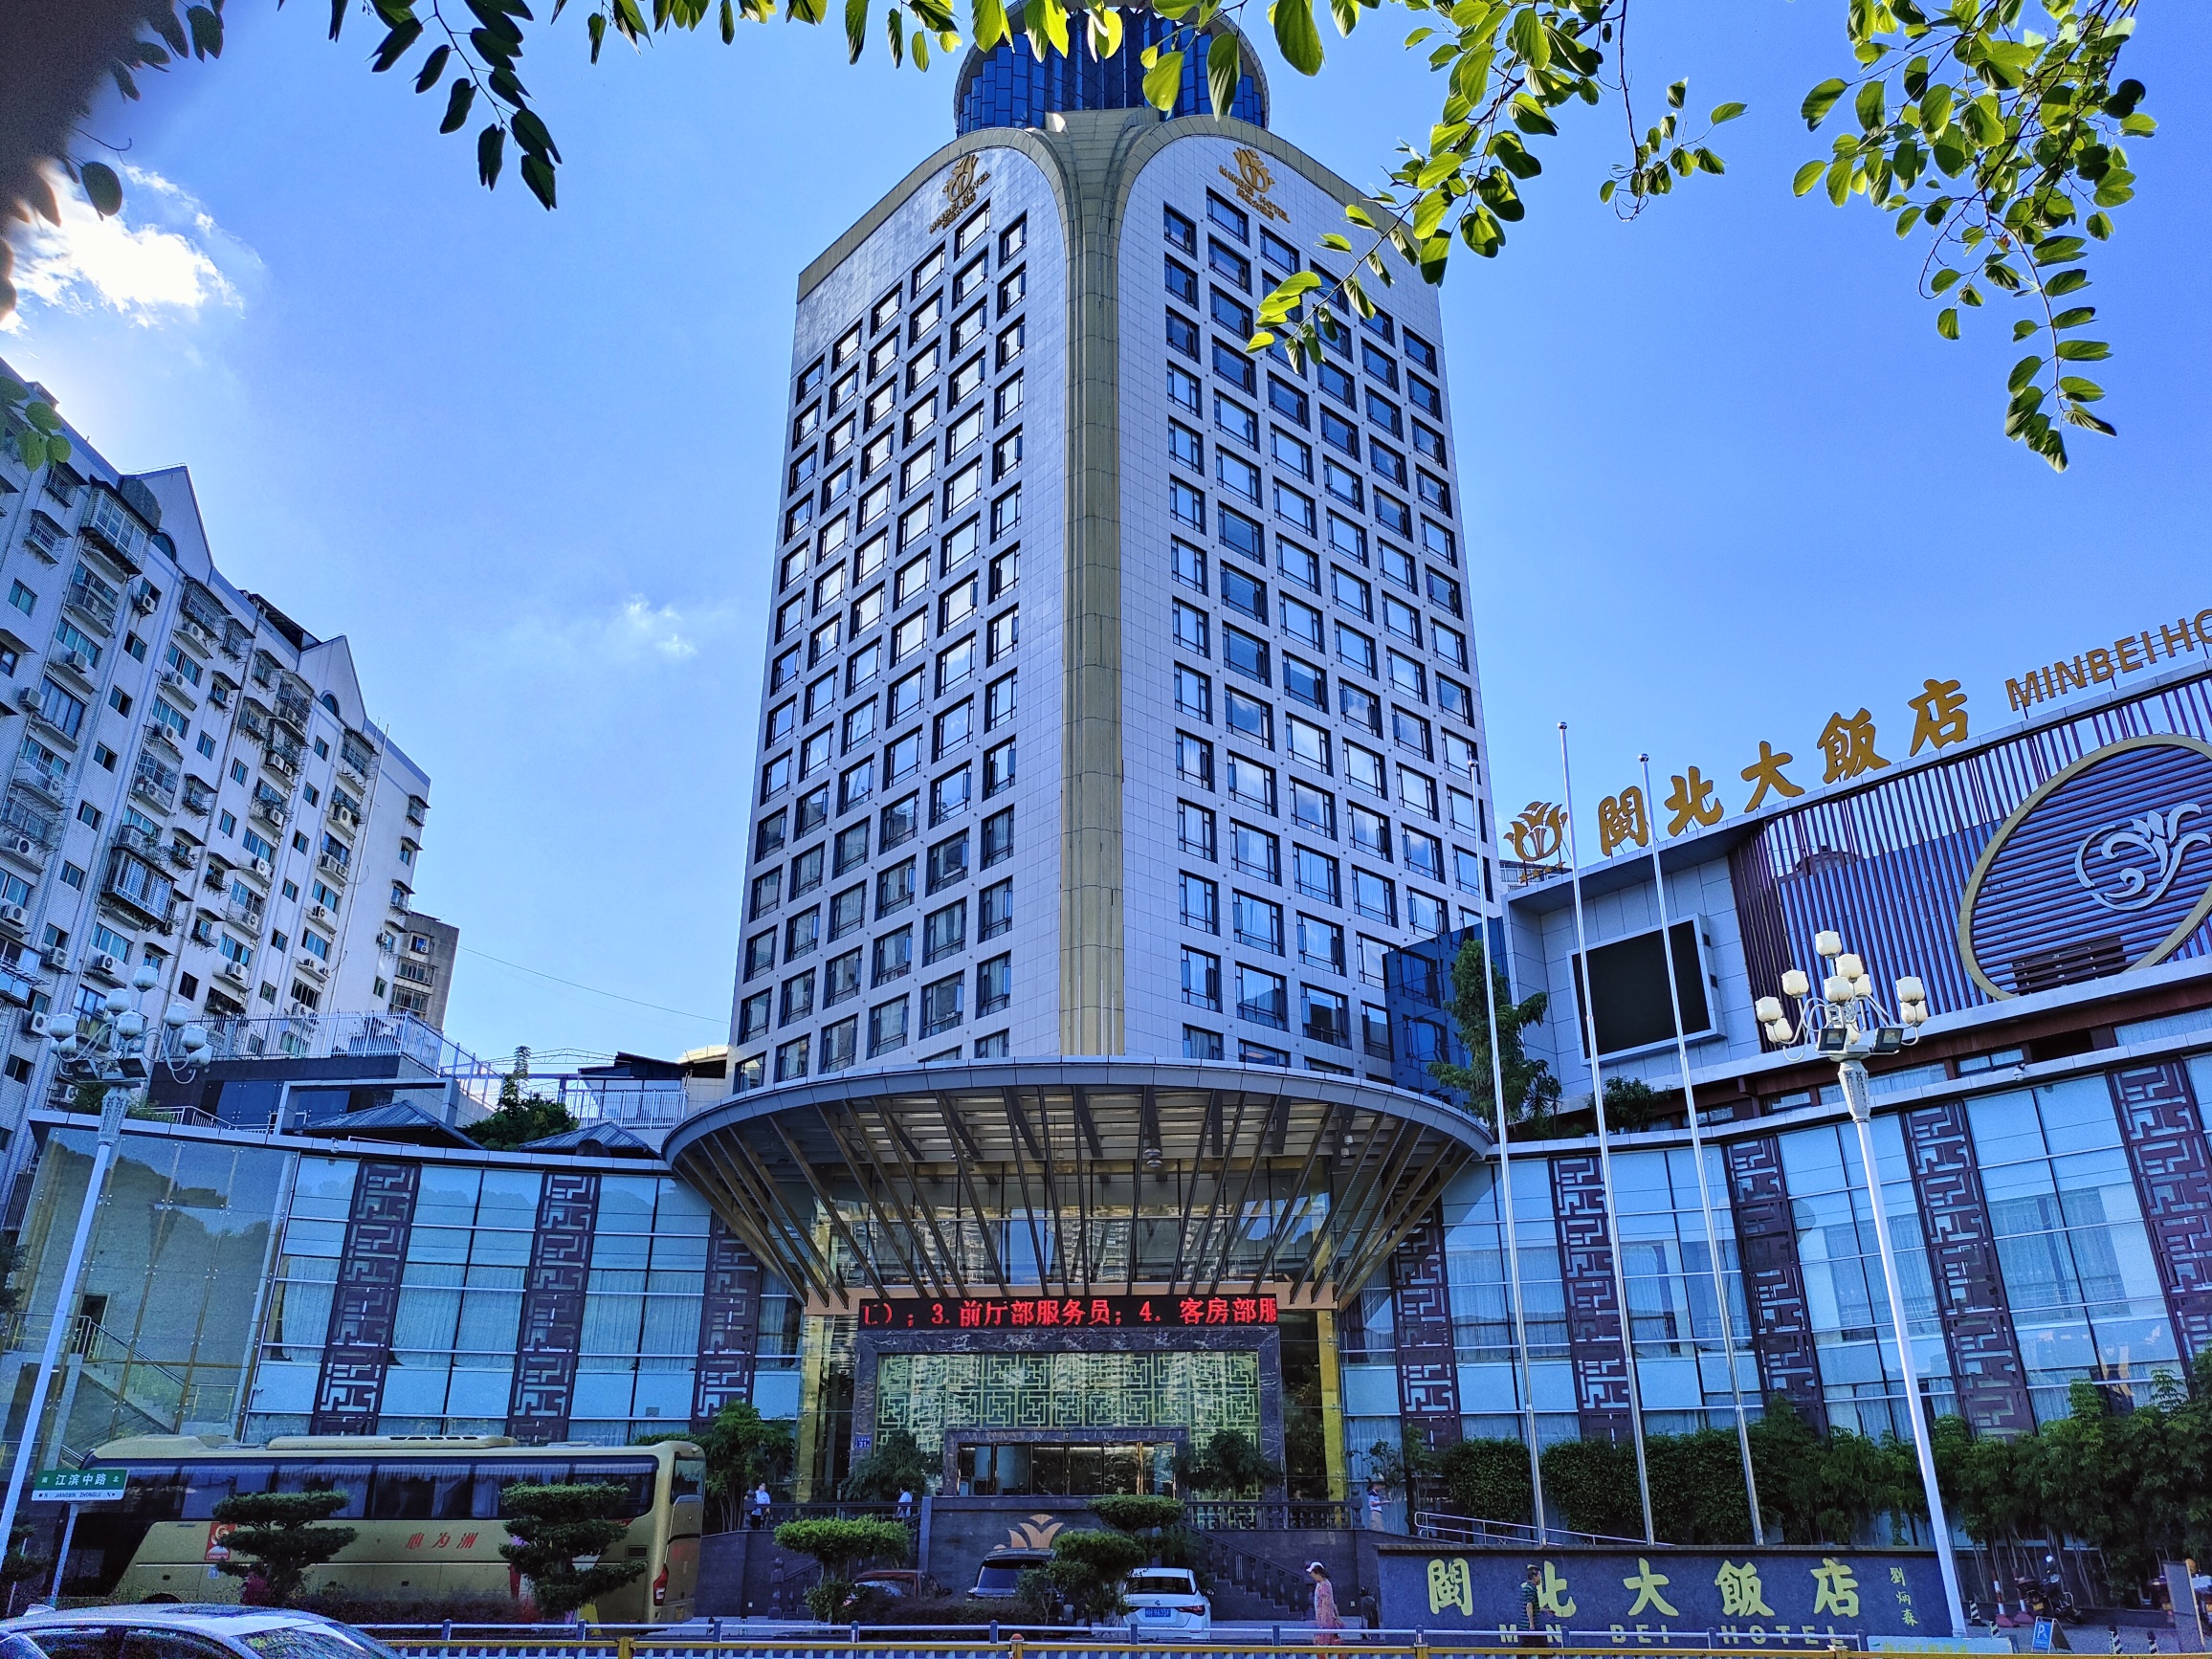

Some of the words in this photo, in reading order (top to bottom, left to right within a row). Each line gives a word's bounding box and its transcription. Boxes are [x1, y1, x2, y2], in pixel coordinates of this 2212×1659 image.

[55, 1473, 107, 1486] 江滨中路
[1720, 1625, 1845, 1646] HOTEL
